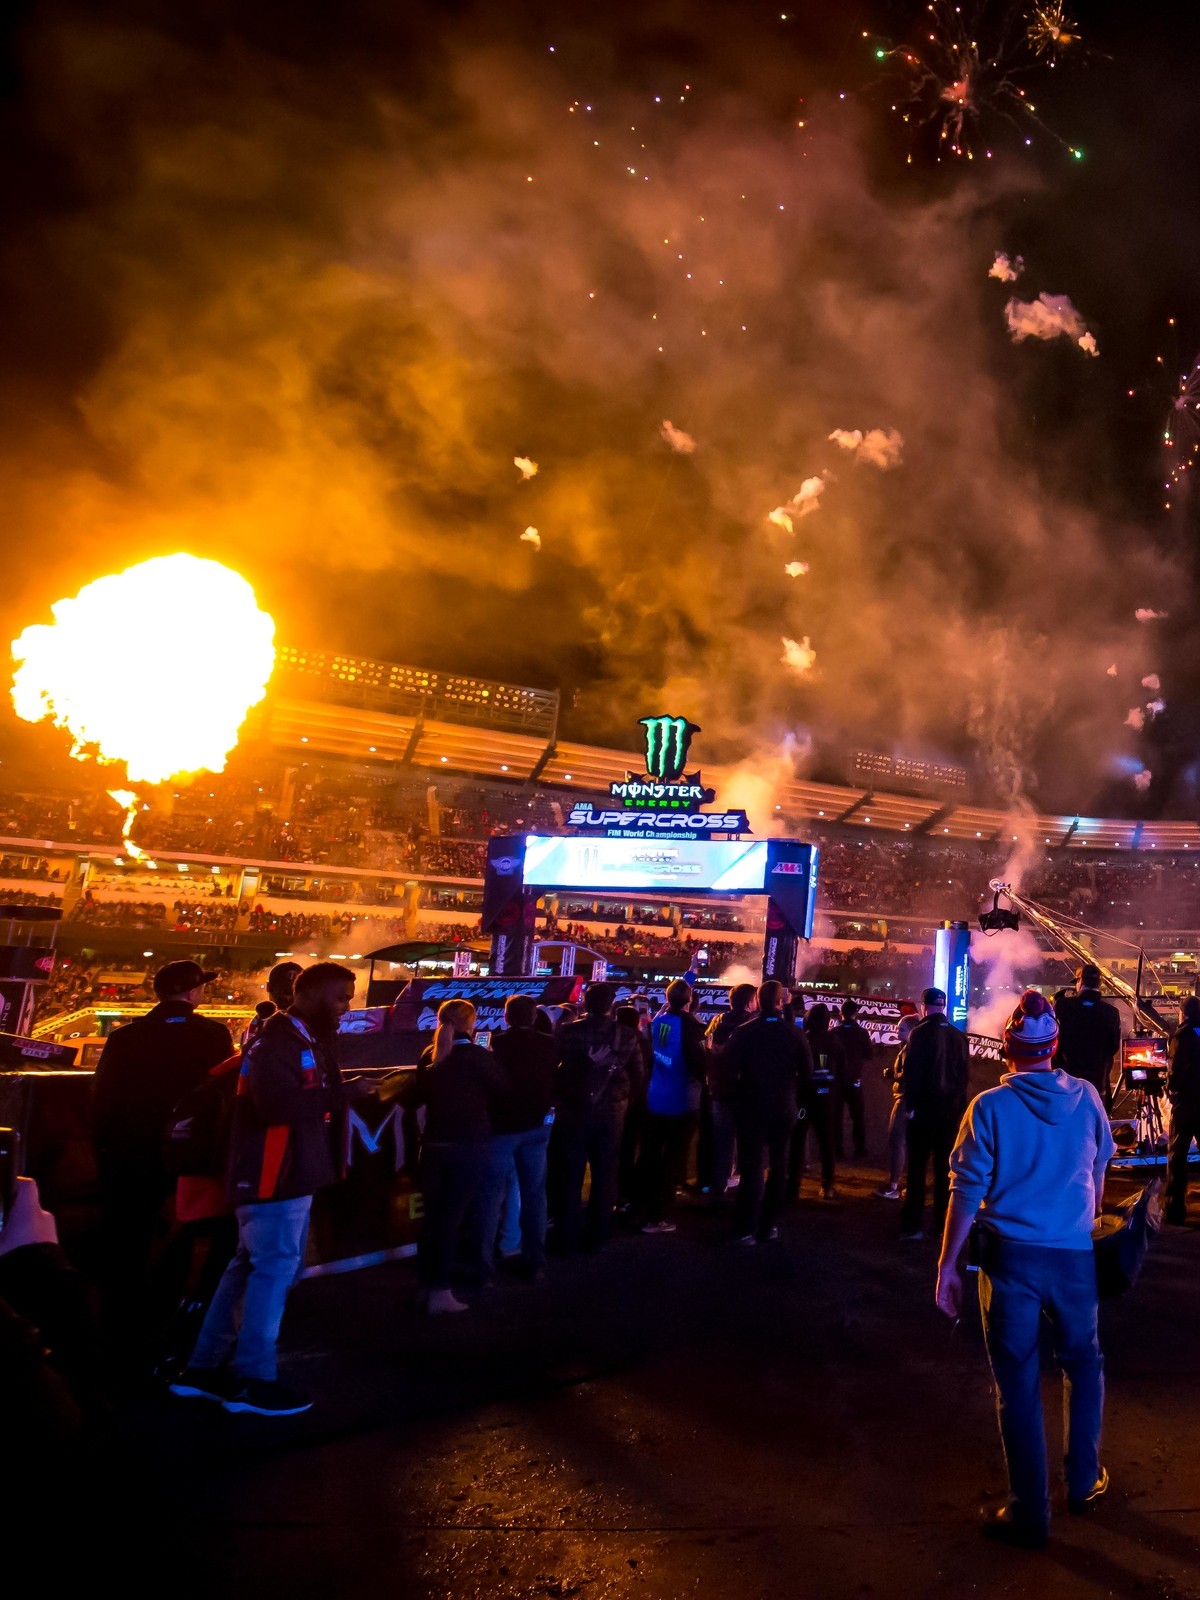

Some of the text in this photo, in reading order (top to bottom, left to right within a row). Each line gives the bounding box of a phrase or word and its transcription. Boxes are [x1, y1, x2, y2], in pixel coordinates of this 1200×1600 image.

[611, 782, 703, 799] MONSTER
[574, 803, 593, 811] AMA
[625, 799, 691, 808] ENERGY
[568, 810, 741, 829] SUPERCROSS
[607, 829, 697, 840] FIM World Championship
[771, 862, 803, 874] AMA
[448, 980, 549, 989] ROCKY MOUNTAIN
[816, 994, 898, 1009] ROCKY MOUNTAIN
